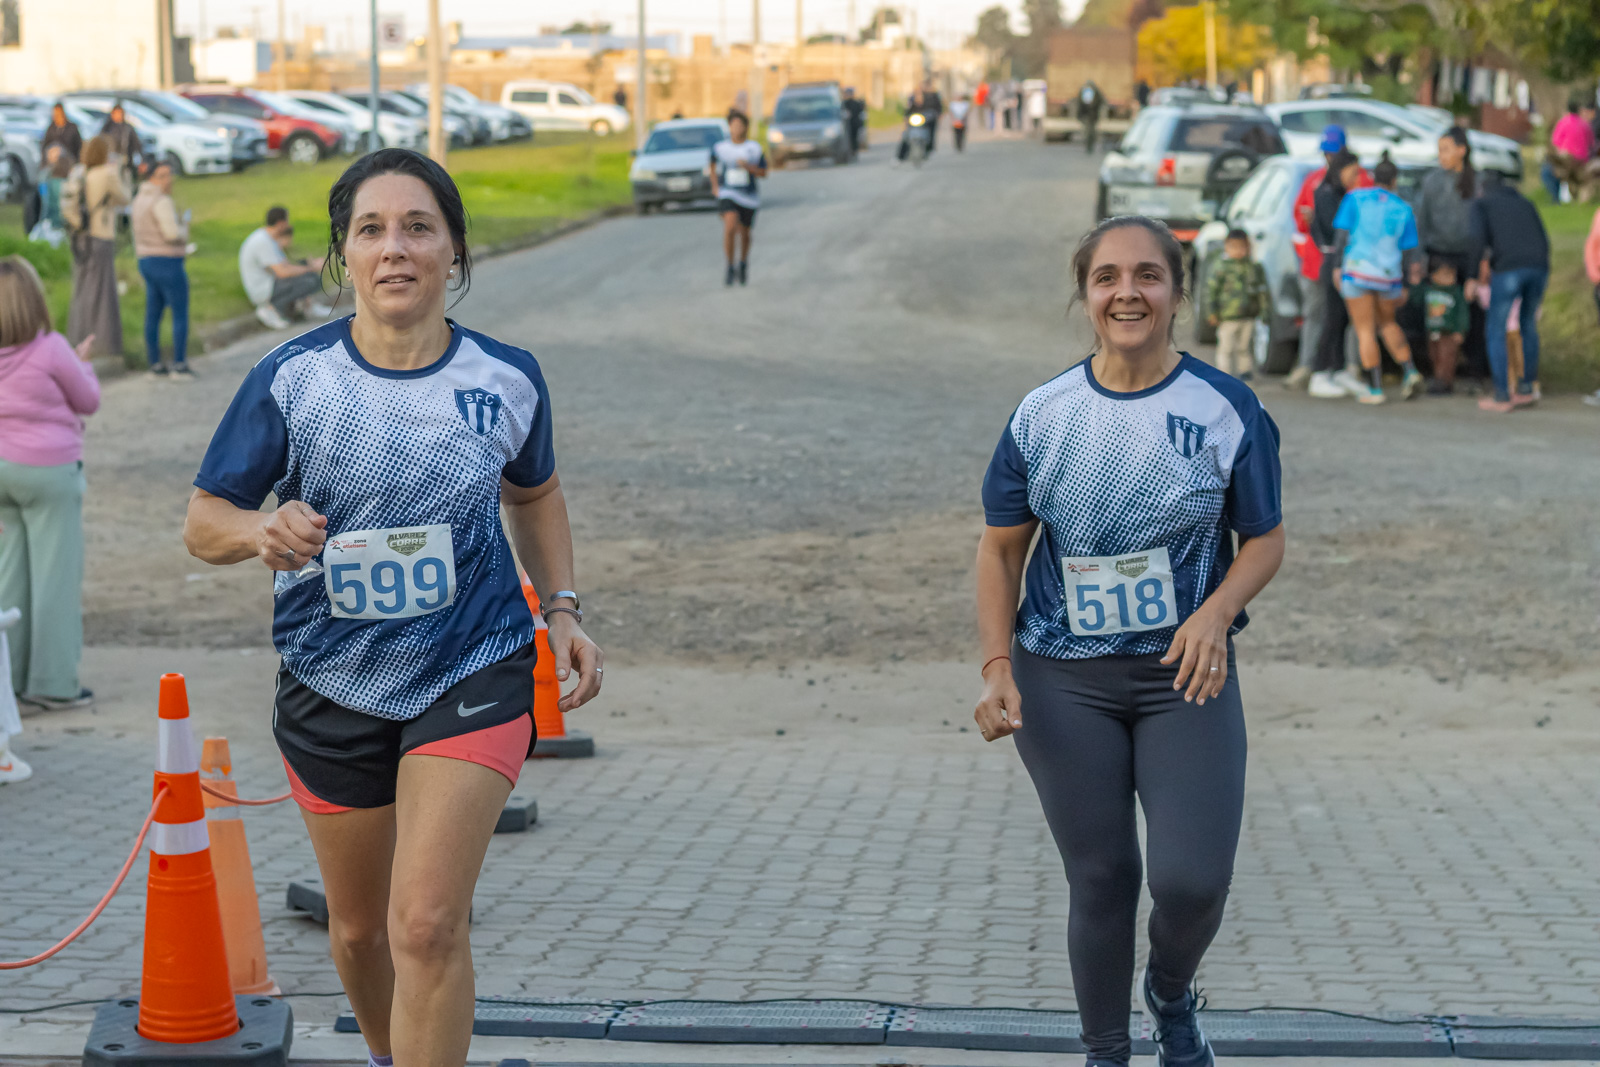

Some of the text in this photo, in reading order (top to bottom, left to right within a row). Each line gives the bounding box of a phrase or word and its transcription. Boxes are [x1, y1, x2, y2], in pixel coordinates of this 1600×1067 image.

[464, 393, 495, 405] SFC
[1174, 419, 1198, 433] SFC
[387, 532, 427, 542] ALVAREZ
[389, 538, 426, 548] CORRE
[330, 557, 448, 615] 599
[1076, 578, 1167, 632] 518
